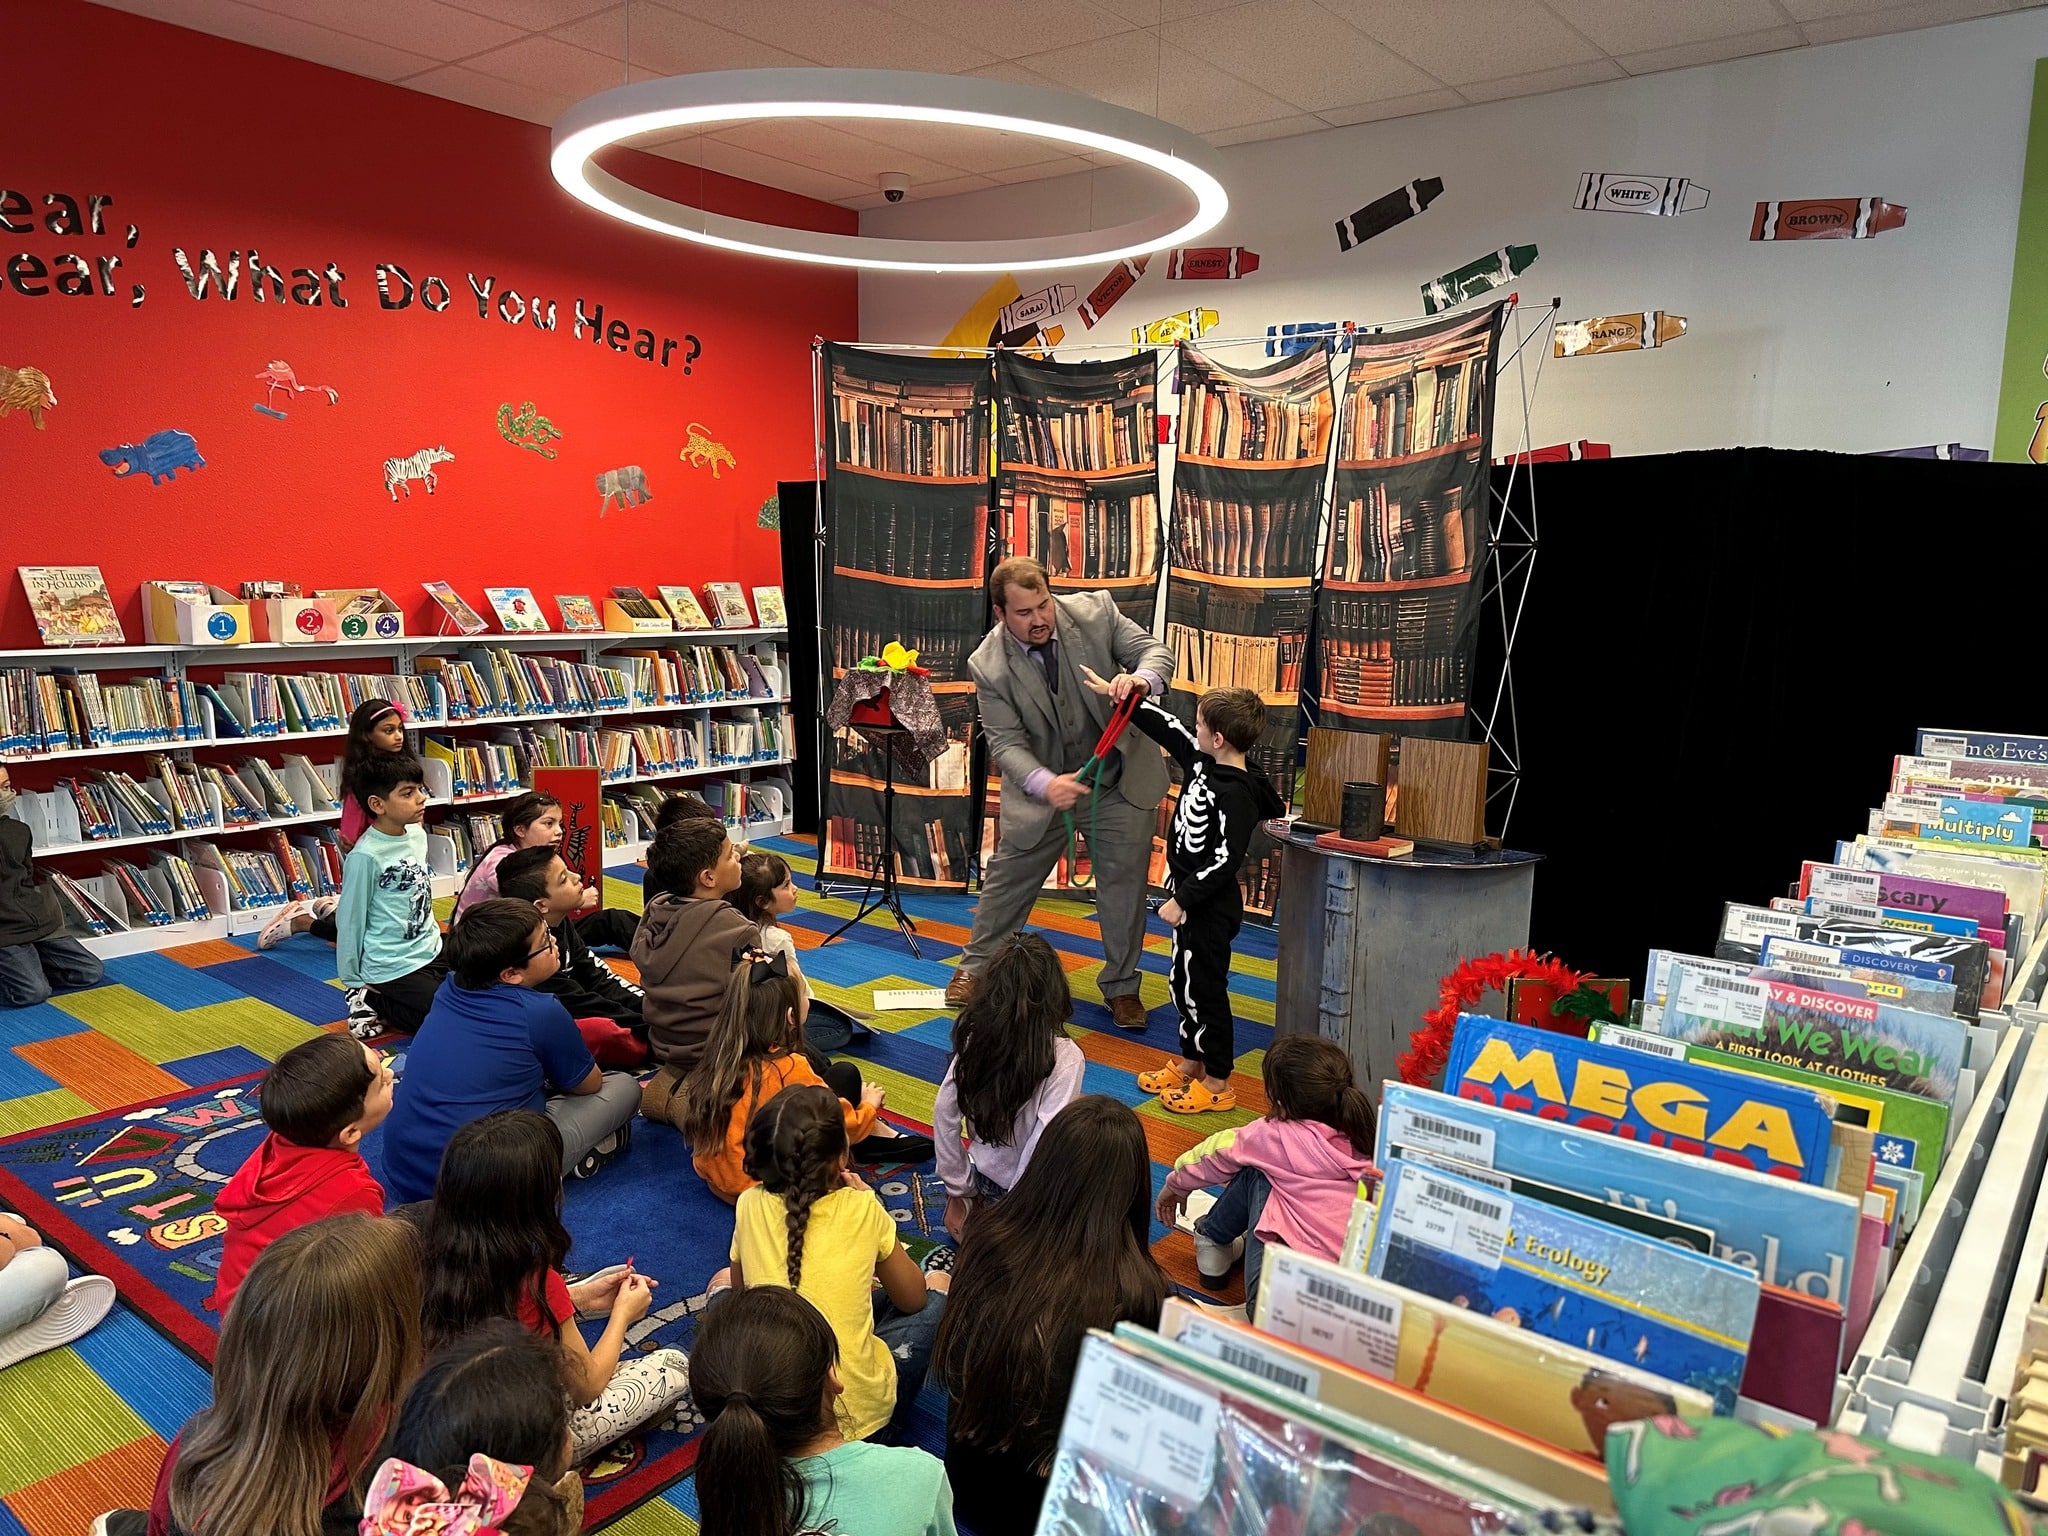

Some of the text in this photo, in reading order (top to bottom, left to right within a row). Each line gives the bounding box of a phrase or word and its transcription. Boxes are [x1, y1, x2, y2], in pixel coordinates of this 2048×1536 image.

[1610, 187, 1652, 202] WHITE
[1788, 213, 1844, 226] BROWN
[1188, 258, 1223, 271] ERNEST
[1097, 274, 1125, 303] VICTOR
[0, 248, 702, 376] ear, What Do You Hear?
[1019, 303, 1044, 319] SARAI
[1591, 326, 1634, 340] RANGE
[32, 580, 96, 590] IN HOLLAND
[219, 619, 228, 632] 1
[306, 615, 314, 627] 2
[351, 621, 359, 633] 3
[382, 620, 391, 631] 4
[1983, 744, 2000, 758] &
[2001, 741, 2048, 761] Eve's
[1926, 817, 2014, 842] Multiply
[1852, 955, 1919, 973] DISCOVERY
[1867, 983, 1899, 996] rld
[1767, 989, 1874, 1019] AY & DISCOVER
[1777, 1016, 1832, 1056] We
[1840, 1028, 1940, 1078] Wear
[1715, 1040, 1887, 1087] A FIRST LOOK AT CLOTHES
[1464, 1037, 1805, 1168] MEGA
[1525, 1234, 1611, 1287] Ecology
